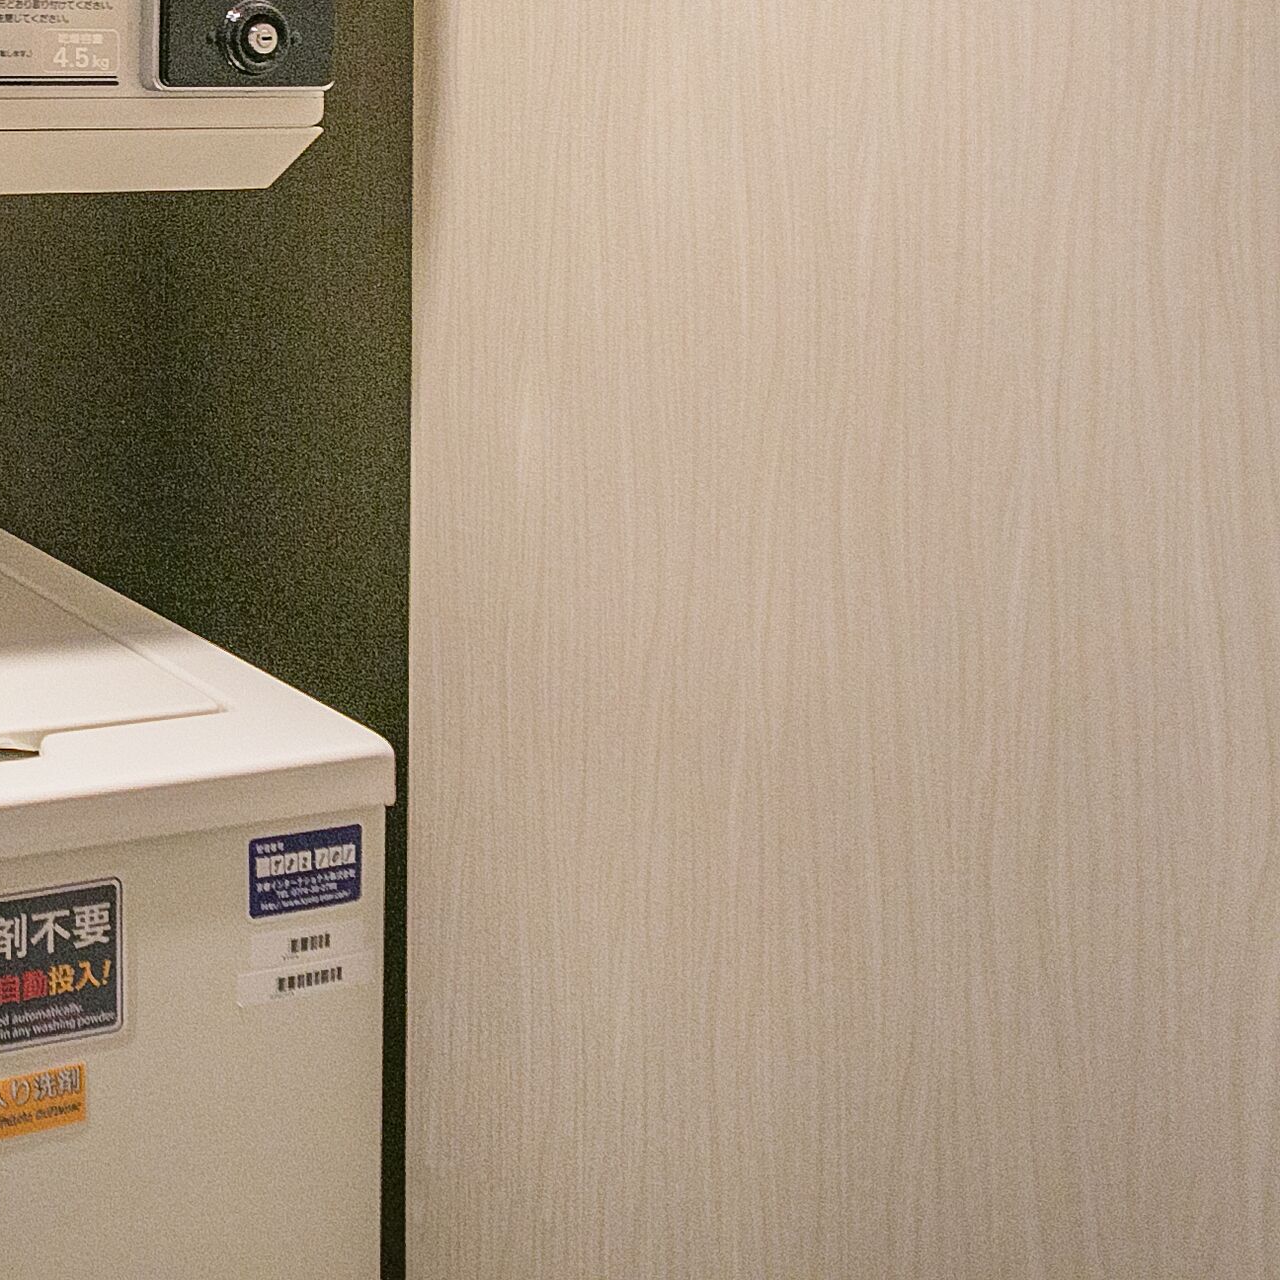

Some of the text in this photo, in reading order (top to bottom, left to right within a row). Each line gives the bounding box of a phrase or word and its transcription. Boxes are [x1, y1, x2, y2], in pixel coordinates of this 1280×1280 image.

[0, 1030, 11, 1040] in
[12, 1027, 31, 1040] any
[32, 1016, 76, 1035] washing
